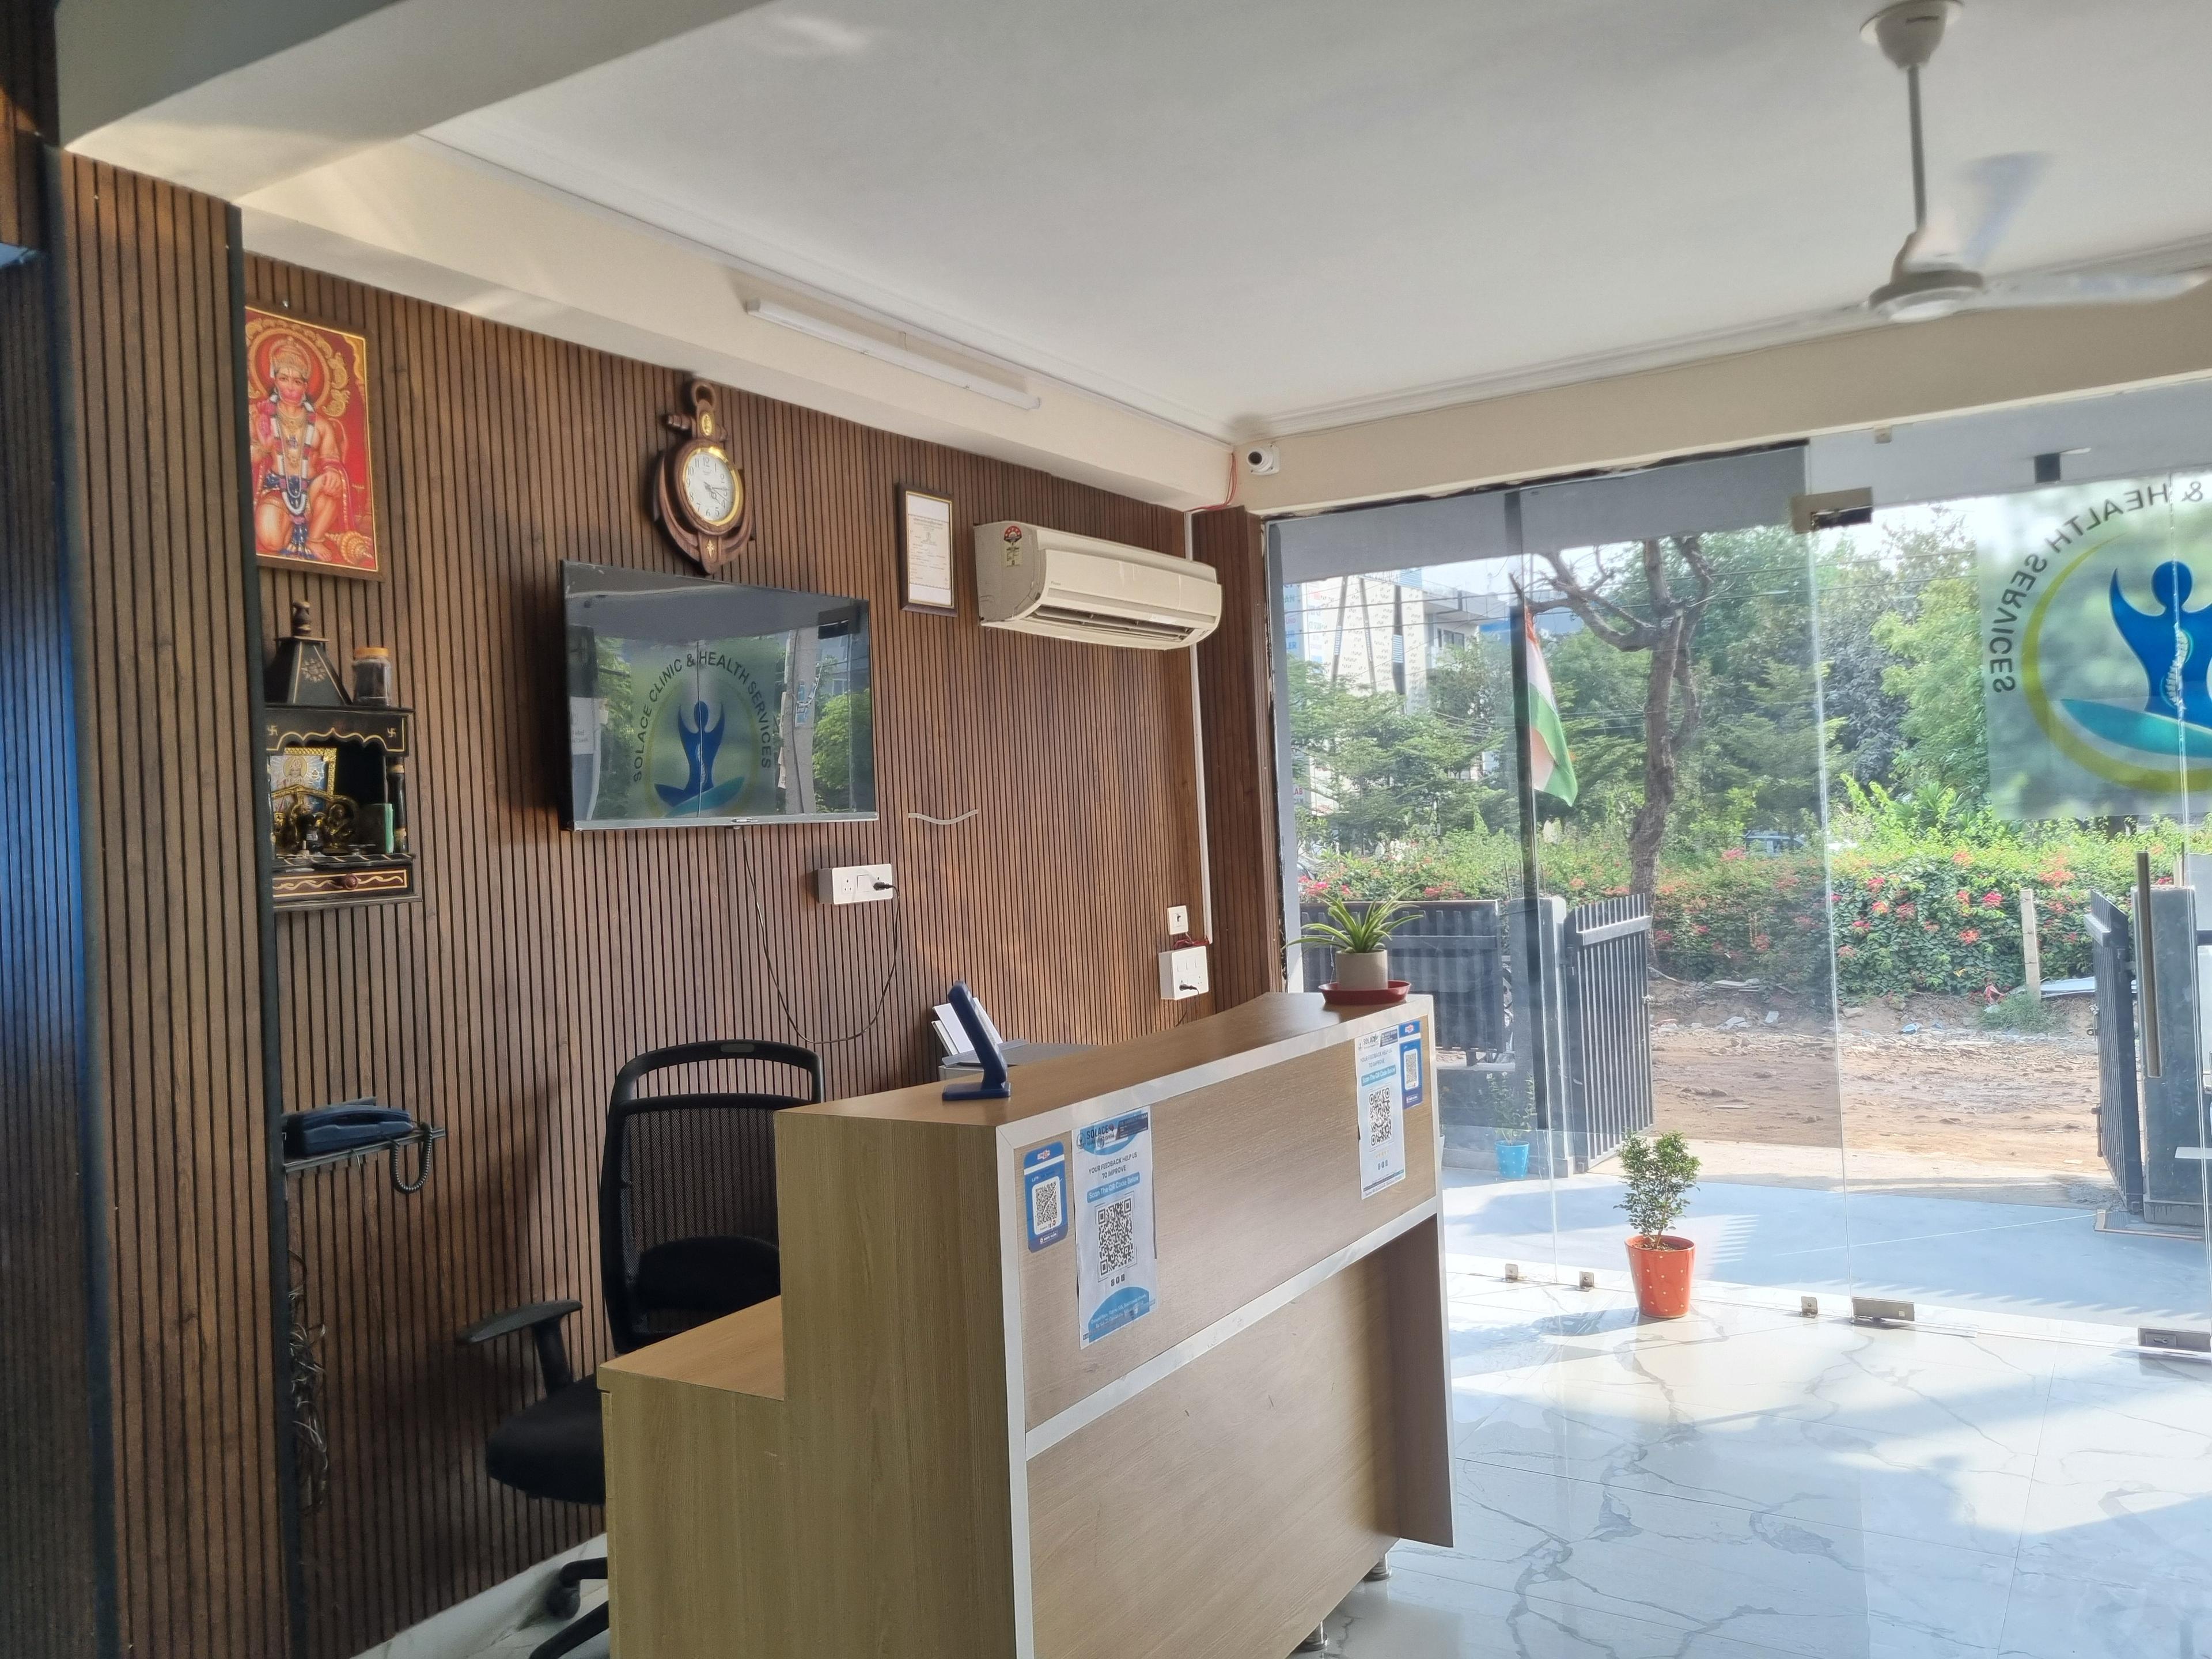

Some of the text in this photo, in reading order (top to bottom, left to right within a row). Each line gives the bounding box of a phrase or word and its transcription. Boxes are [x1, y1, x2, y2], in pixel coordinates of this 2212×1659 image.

[695, 457, 699, 468] 11
[703, 456, 710, 467] 12
[687, 465, 694, 476] 10
[686, 478, 691, 487] 9
[690, 492, 694, 502] 8
[696, 502, 701, 512] 7
[721, 499, 725, 508] 4
[706, 509, 711, 517] 6
[715, 507, 719, 517] 5
[634, 651, 771, 782] SOLACE CLINIC & HEALTH SERVICES
[1086, 1124, 1109, 1139] SOLACE
[1088, 1165, 1101, 1175] YOUR
[1101, 1157, 1122, 1170] FEEDBACK
[1122, 1154, 1131, 1162] HELP
[1108, 1165, 1126, 1177] IMPROVE
[1089, 1190, 1100, 1199] Scan
[1108, 1183, 1115, 1191] QR
